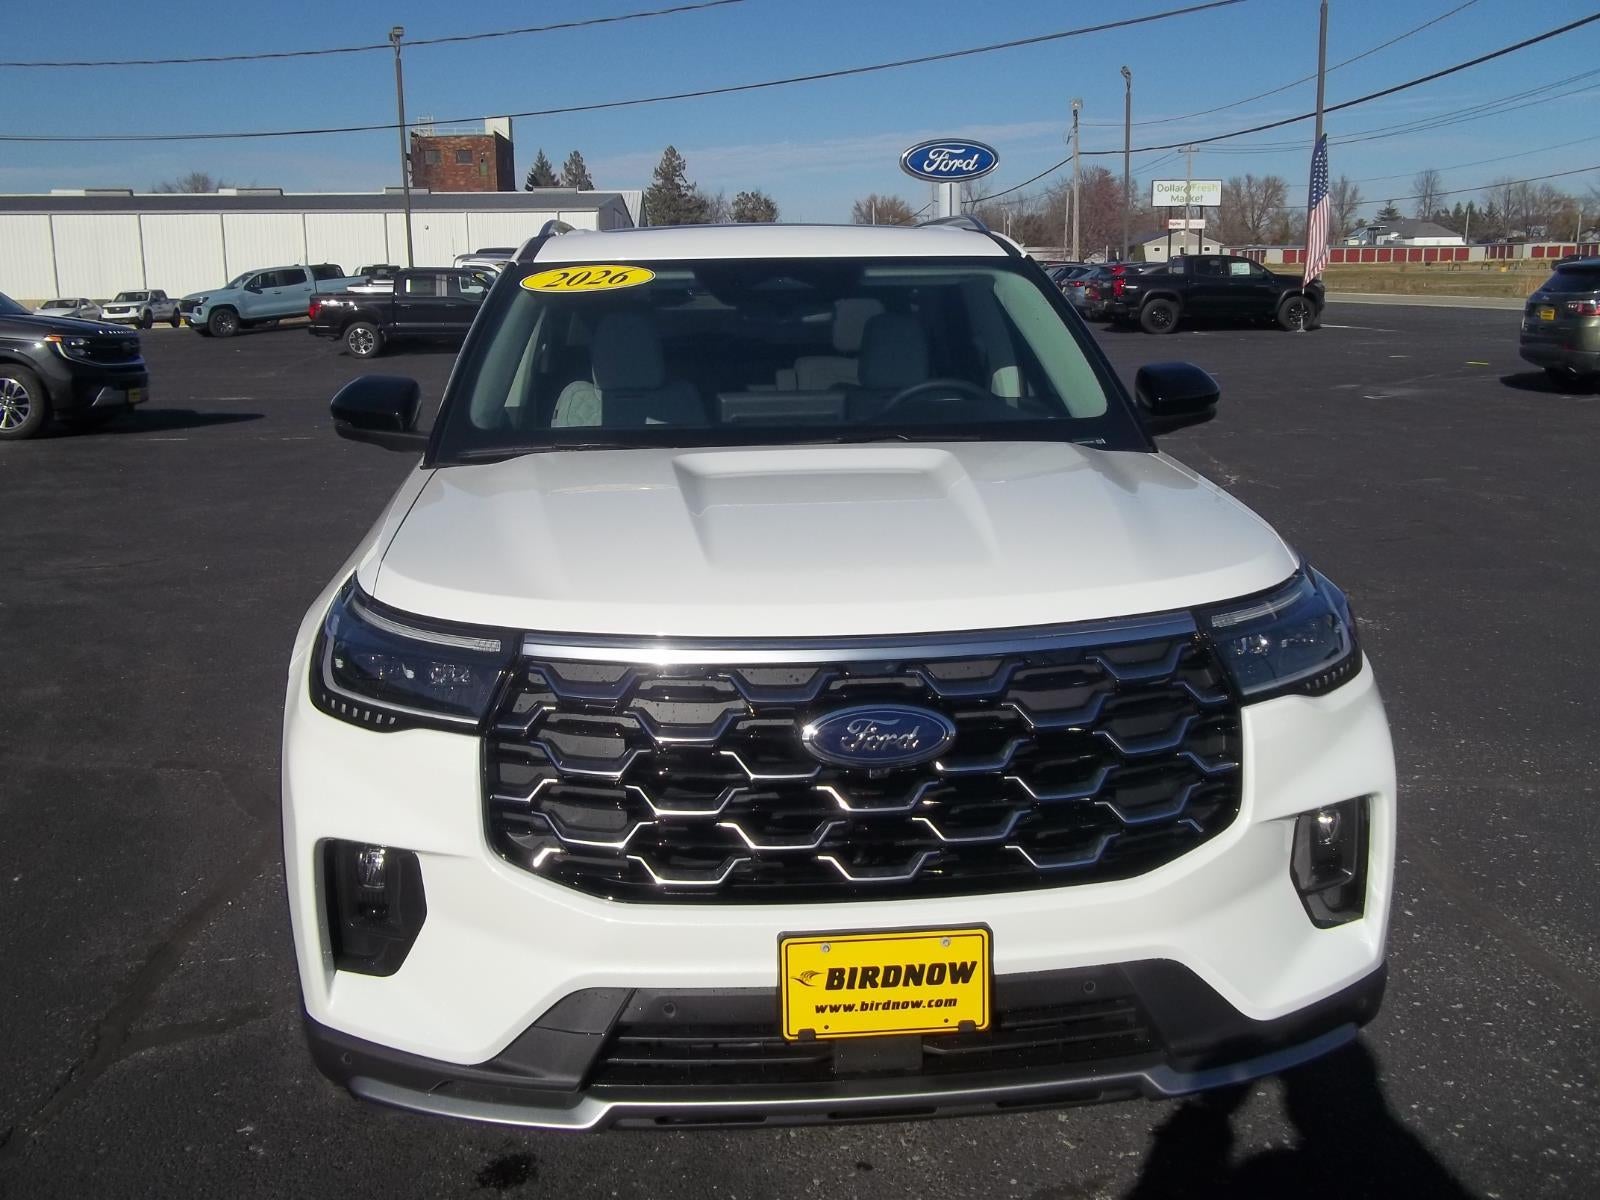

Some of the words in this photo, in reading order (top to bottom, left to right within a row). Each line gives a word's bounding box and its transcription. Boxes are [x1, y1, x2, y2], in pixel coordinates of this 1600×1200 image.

[923, 148, 978, 172] Ford
[1157, 183, 1184, 193] Dollar
[1170, 195, 1203, 203] Maket
[543, 270, 632, 288] 2026
[840, 718, 920, 751] Ford
[825, 960, 978, 991] BIRDNOW
[814, 997, 958, 1014] www.birdnow.com
